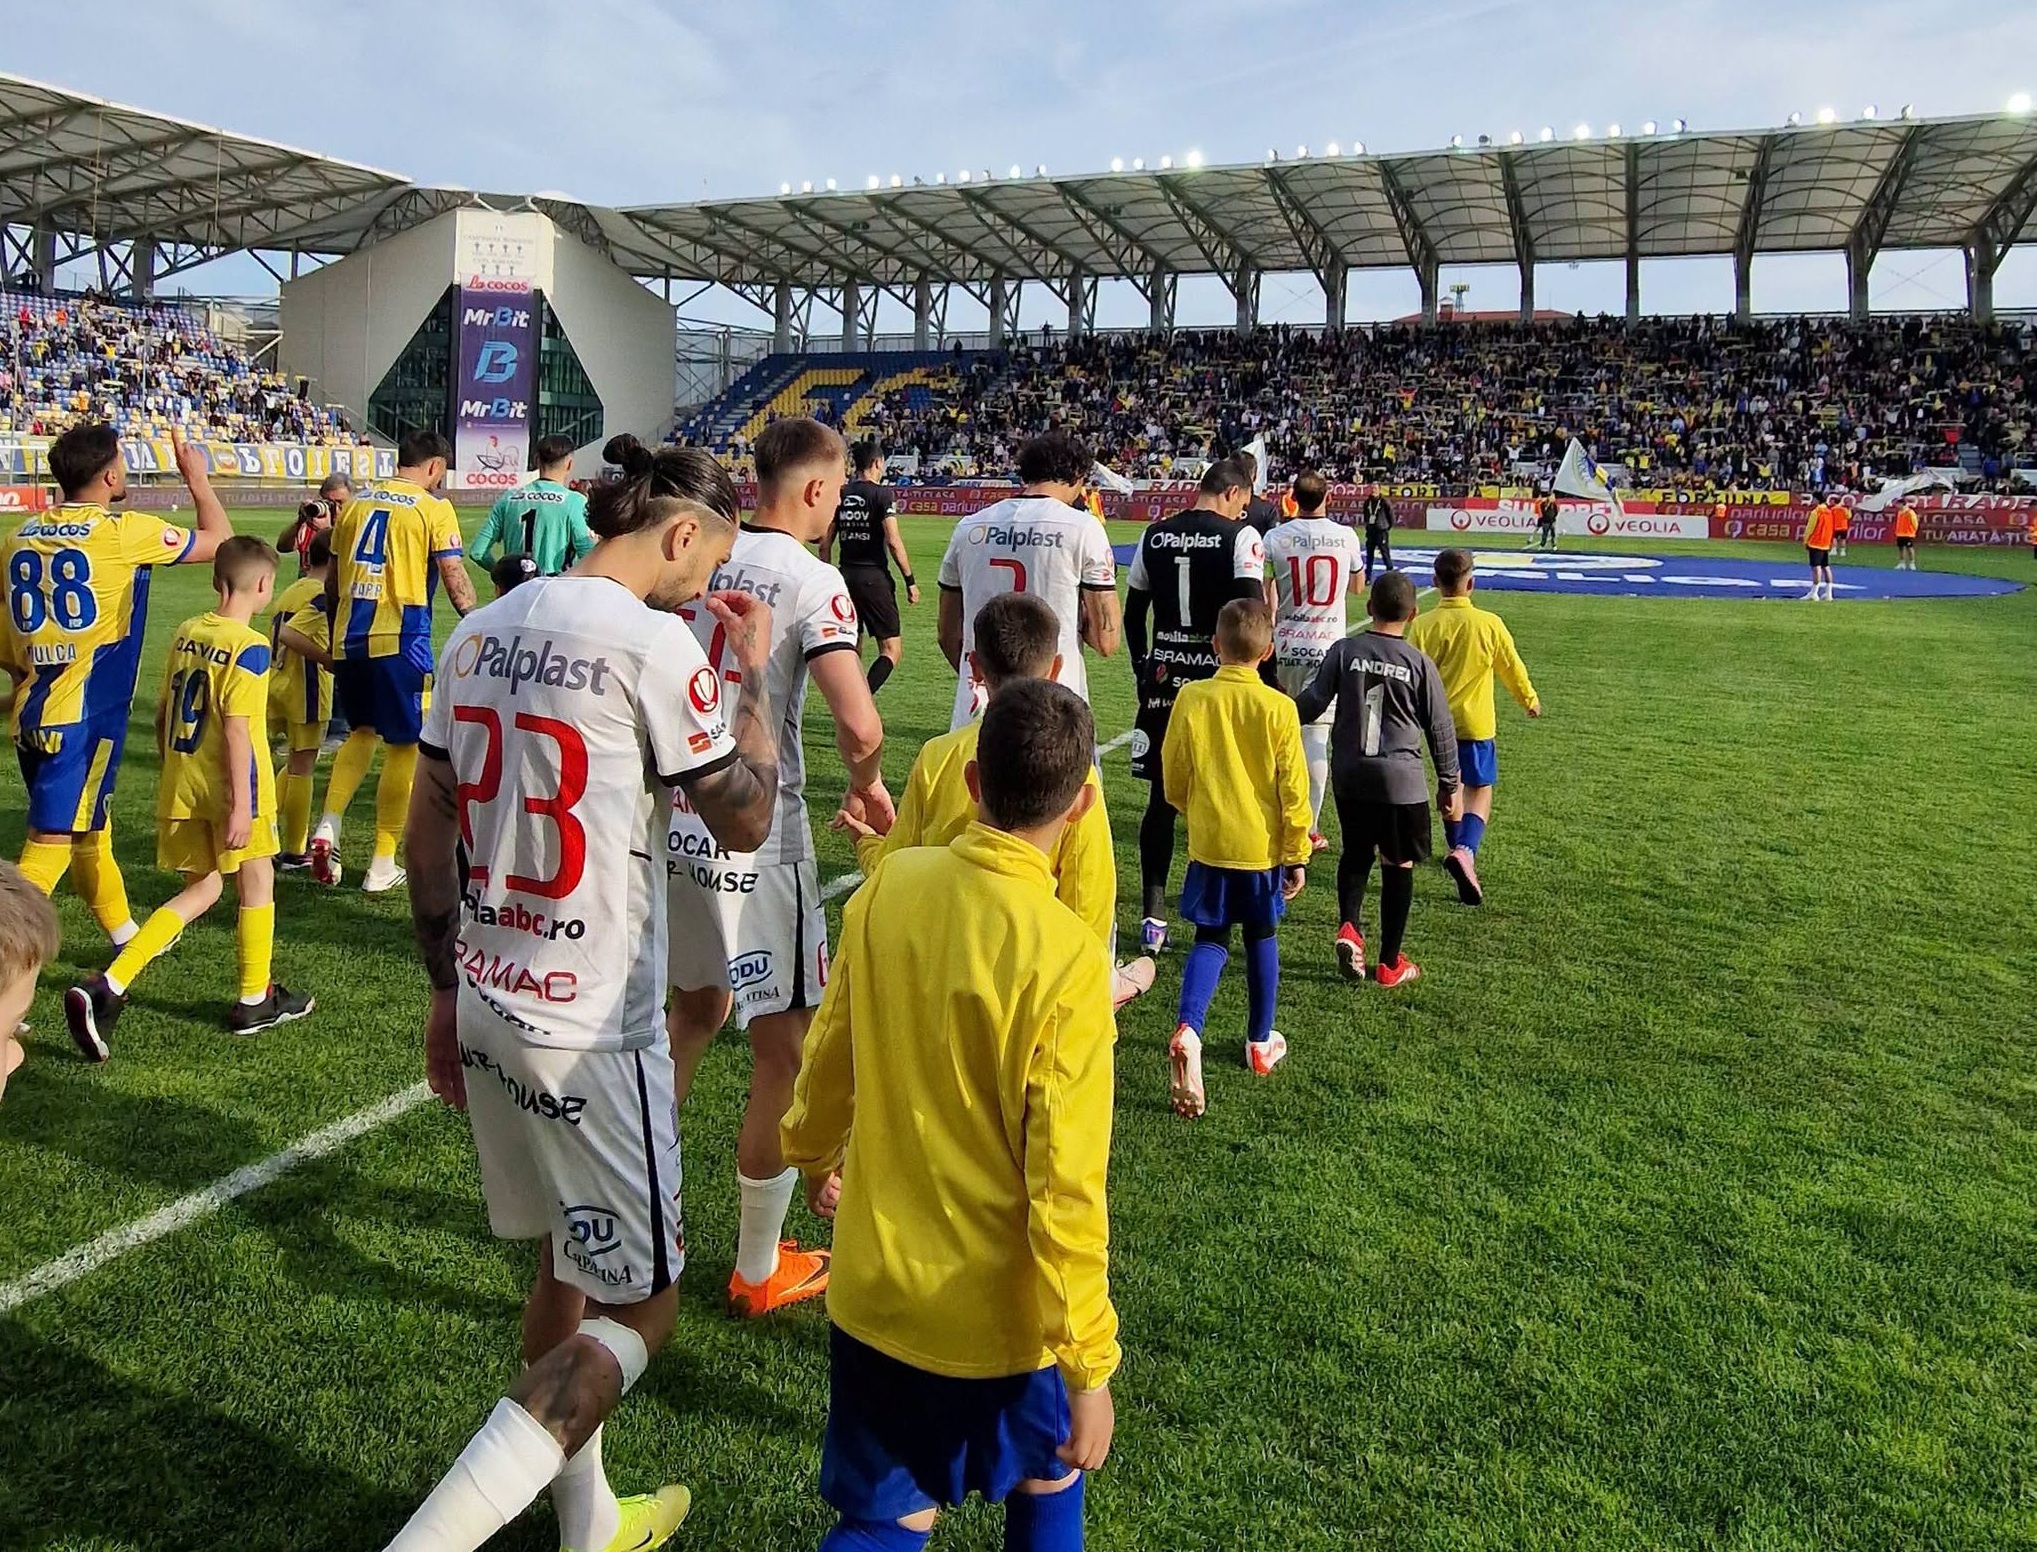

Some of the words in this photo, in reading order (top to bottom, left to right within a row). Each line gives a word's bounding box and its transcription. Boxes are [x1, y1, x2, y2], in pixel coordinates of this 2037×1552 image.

[463, 306, 530, 328] MrBit
[460, 397, 528, 419] MrBit
[909, 501, 937, 512] casa
[521, 508, 538, 559] 1
[1476, 515, 1537, 528] VEOLIA
[1615, 520, 1681, 533] VEOLIA
[1746, 523, 1790, 537] casa
[355, 509, 391, 564] 4
[985, 526, 1064, 552] Palplast
[1162, 532, 1222, 553] Palplast
[1292, 534, 1346, 551] Palplast
[9, 547, 98, 633] 88
[1174, 556, 1192, 627] 1
[1286, 554, 1339, 607] 10
[474, 635, 610, 696] Palplast
[1349, 657, 1411, 683] ANDREI
[168, 669, 211, 755] 19
[1364, 683, 1385, 757] 1
